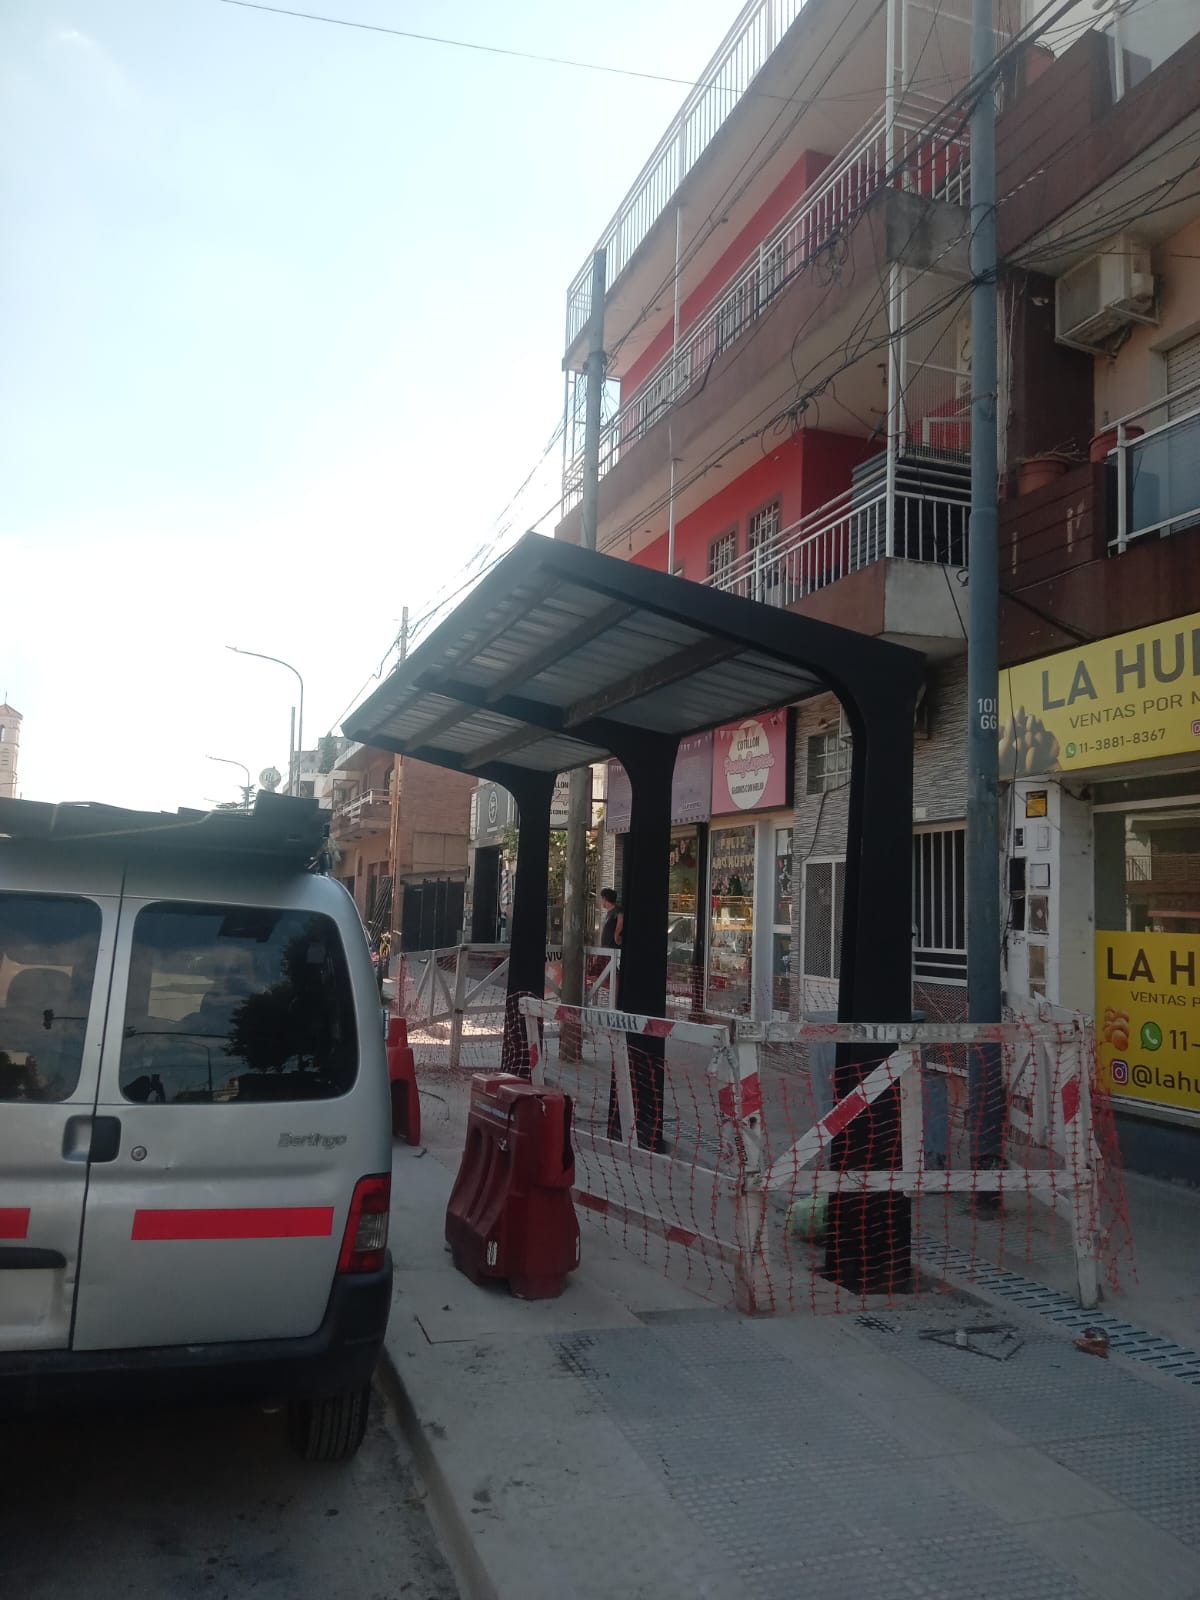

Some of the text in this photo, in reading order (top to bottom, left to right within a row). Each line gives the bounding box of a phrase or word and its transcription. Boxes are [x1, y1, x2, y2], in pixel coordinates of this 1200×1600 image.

[1042, 660, 1098, 711] LA
[1069, 703, 1136, 729] VENTAS
[1143, 694, 1183, 716] POR
[1079, 728, 1166, 753] 11-3881-8367
[1107, 947, 1155, 983] LA
[1131, 991, 1186, 1006] VENTAS
[278, 1132, 348, 1150] Berlingo
